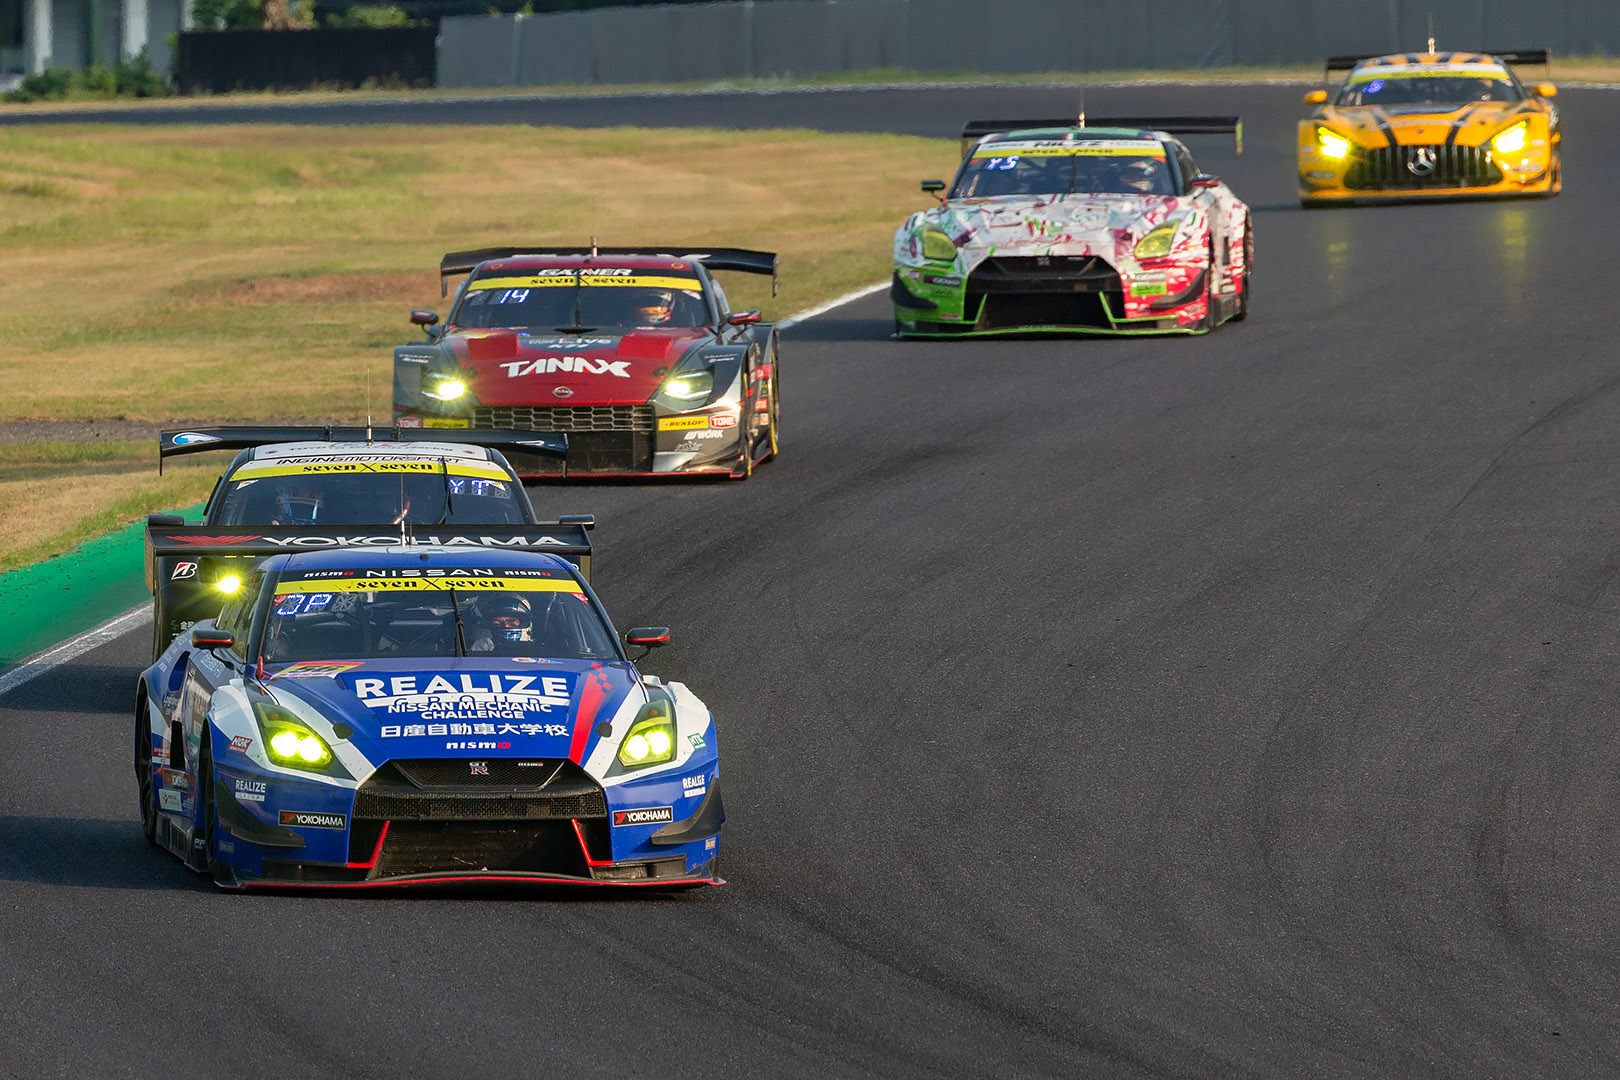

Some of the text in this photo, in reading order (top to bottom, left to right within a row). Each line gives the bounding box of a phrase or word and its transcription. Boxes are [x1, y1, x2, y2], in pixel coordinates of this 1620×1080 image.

[500, 288, 530, 304] 14
[499, 356, 632, 378] TANAX
[669, 419, 705, 427] DUNLOP
[712, 417, 735, 426] TONE
[697, 429, 724, 439] WORK
[303, 464, 356, 472] seven
[380, 463, 433, 471] seven
[262, 536, 570, 546] YOKOHAMA
[366, 568, 494, 577] NISSAN
[356, 580, 417, 588] seven
[445, 579, 505, 588] seven
[354, 674, 571, 698] REALIZE
[388, 701, 552, 714] NISSAN MECHANIC
[421, 710, 525, 720] CHALLENGE
[381, 723, 570, 738] 日産自動車大学校
[231, 737, 251, 748] NGK
[235, 780, 267, 794] REALIZE
[682, 774, 705, 790] REALIZE
[296, 815, 344, 826] YOKOHAMA
[626, 809, 671, 822] YOKOHAMA
